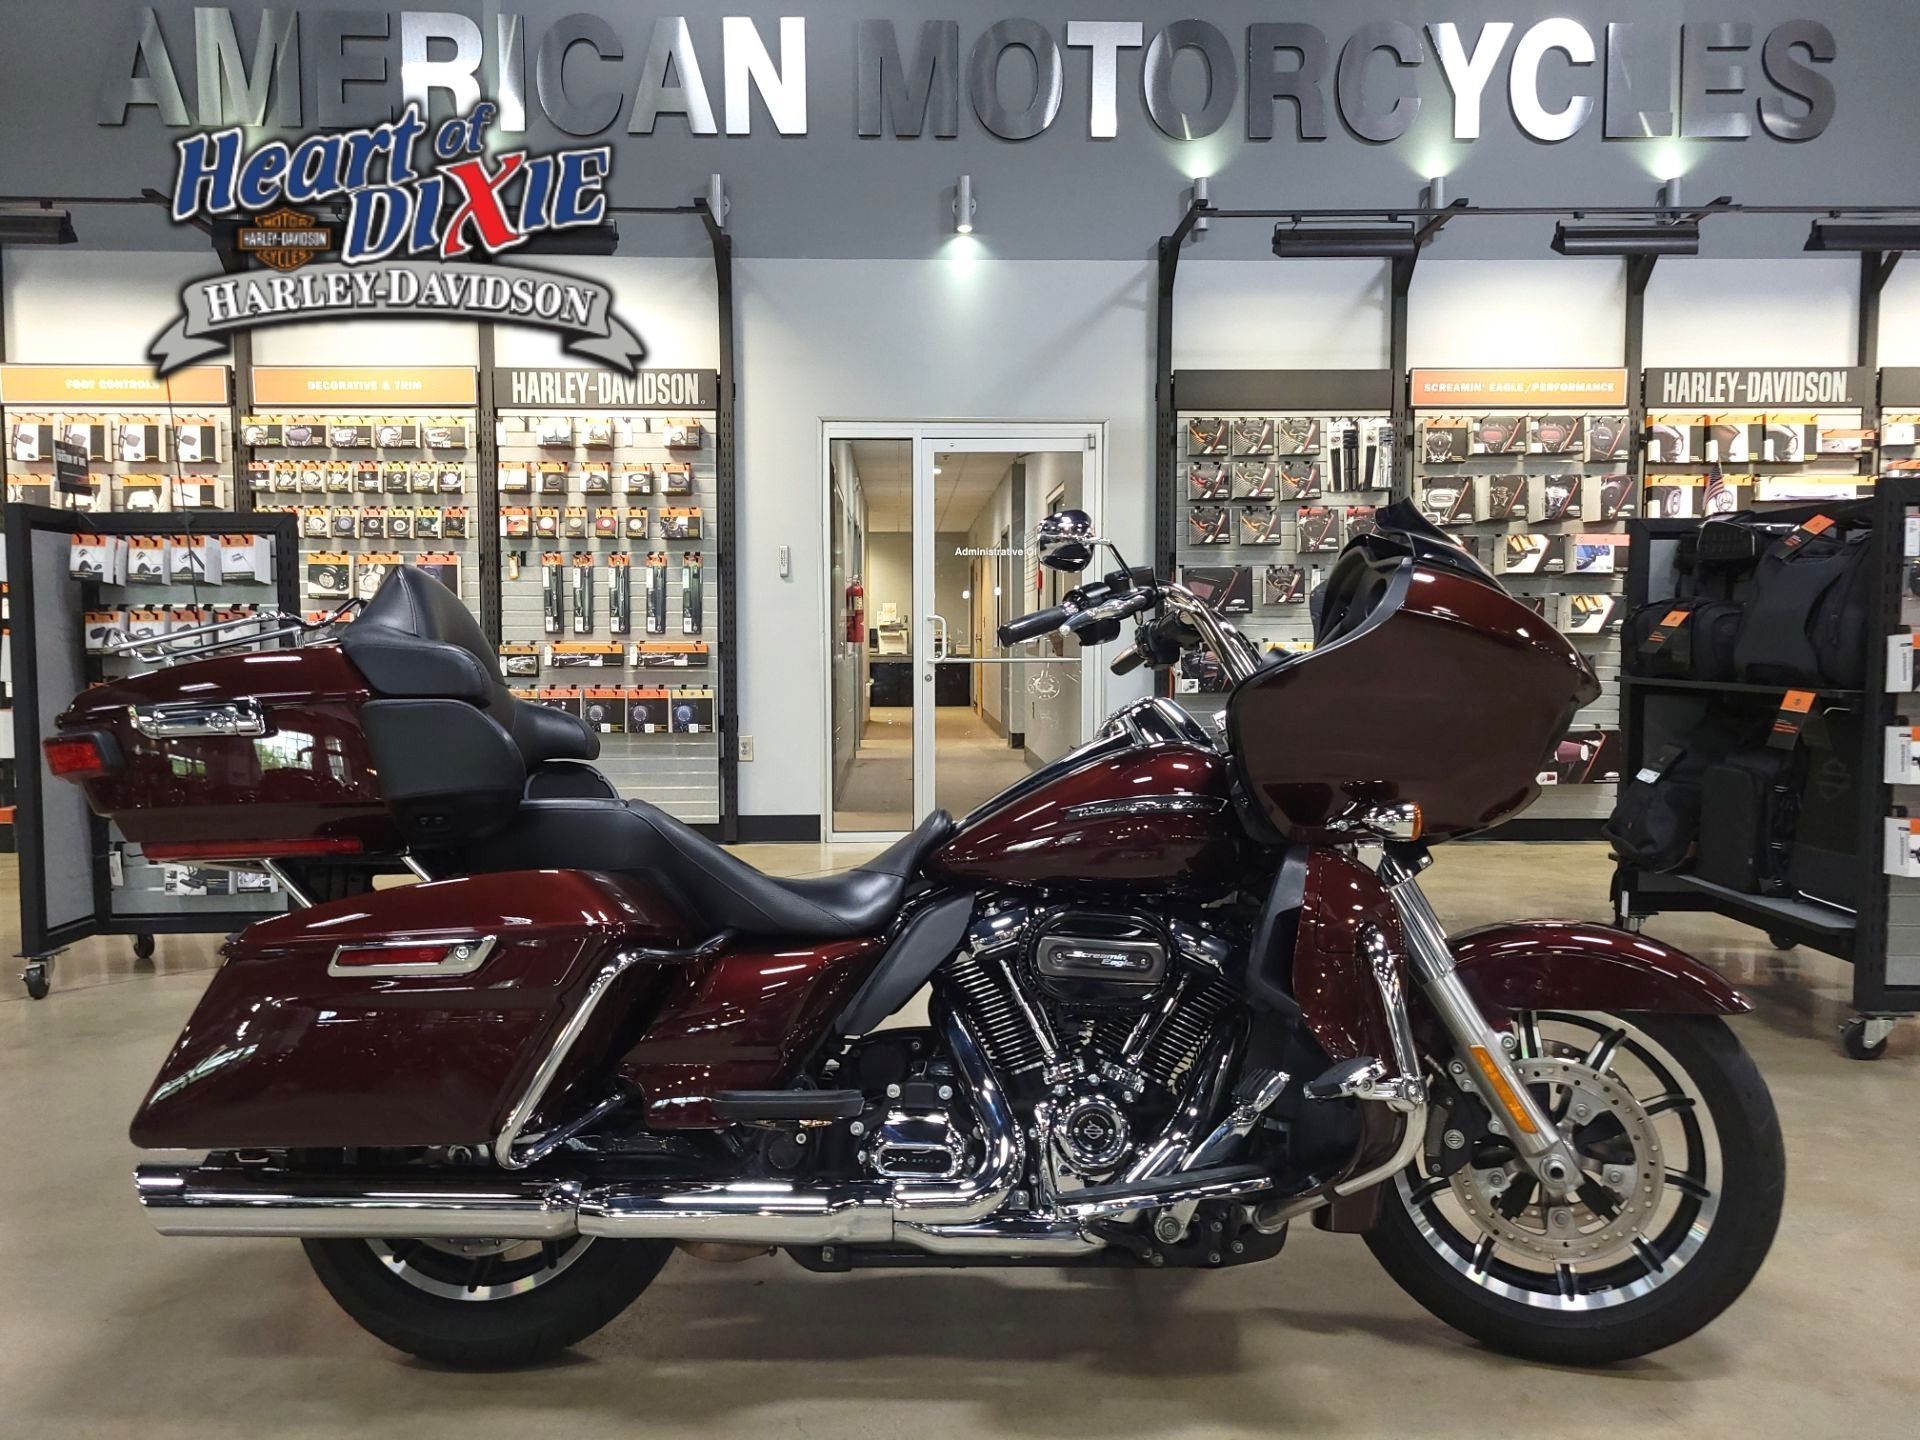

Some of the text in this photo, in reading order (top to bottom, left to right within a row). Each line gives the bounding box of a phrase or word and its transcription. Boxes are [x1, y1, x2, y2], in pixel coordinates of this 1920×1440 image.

[98, 7, 1836, 142] AMERICAN MOTORCYCLES
[307, 380, 378, 391] DECORATIVE
[395, 380, 422, 391] TRIM
[511, 371, 700, 405] HARLEY-DAVIDSON
[1423, 383, 1485, 393] SCREAMIN'
[1662, 371, 1848, 403] HARLEY-DAVIDSON
[954, 546, 1024, 557] Administrative
